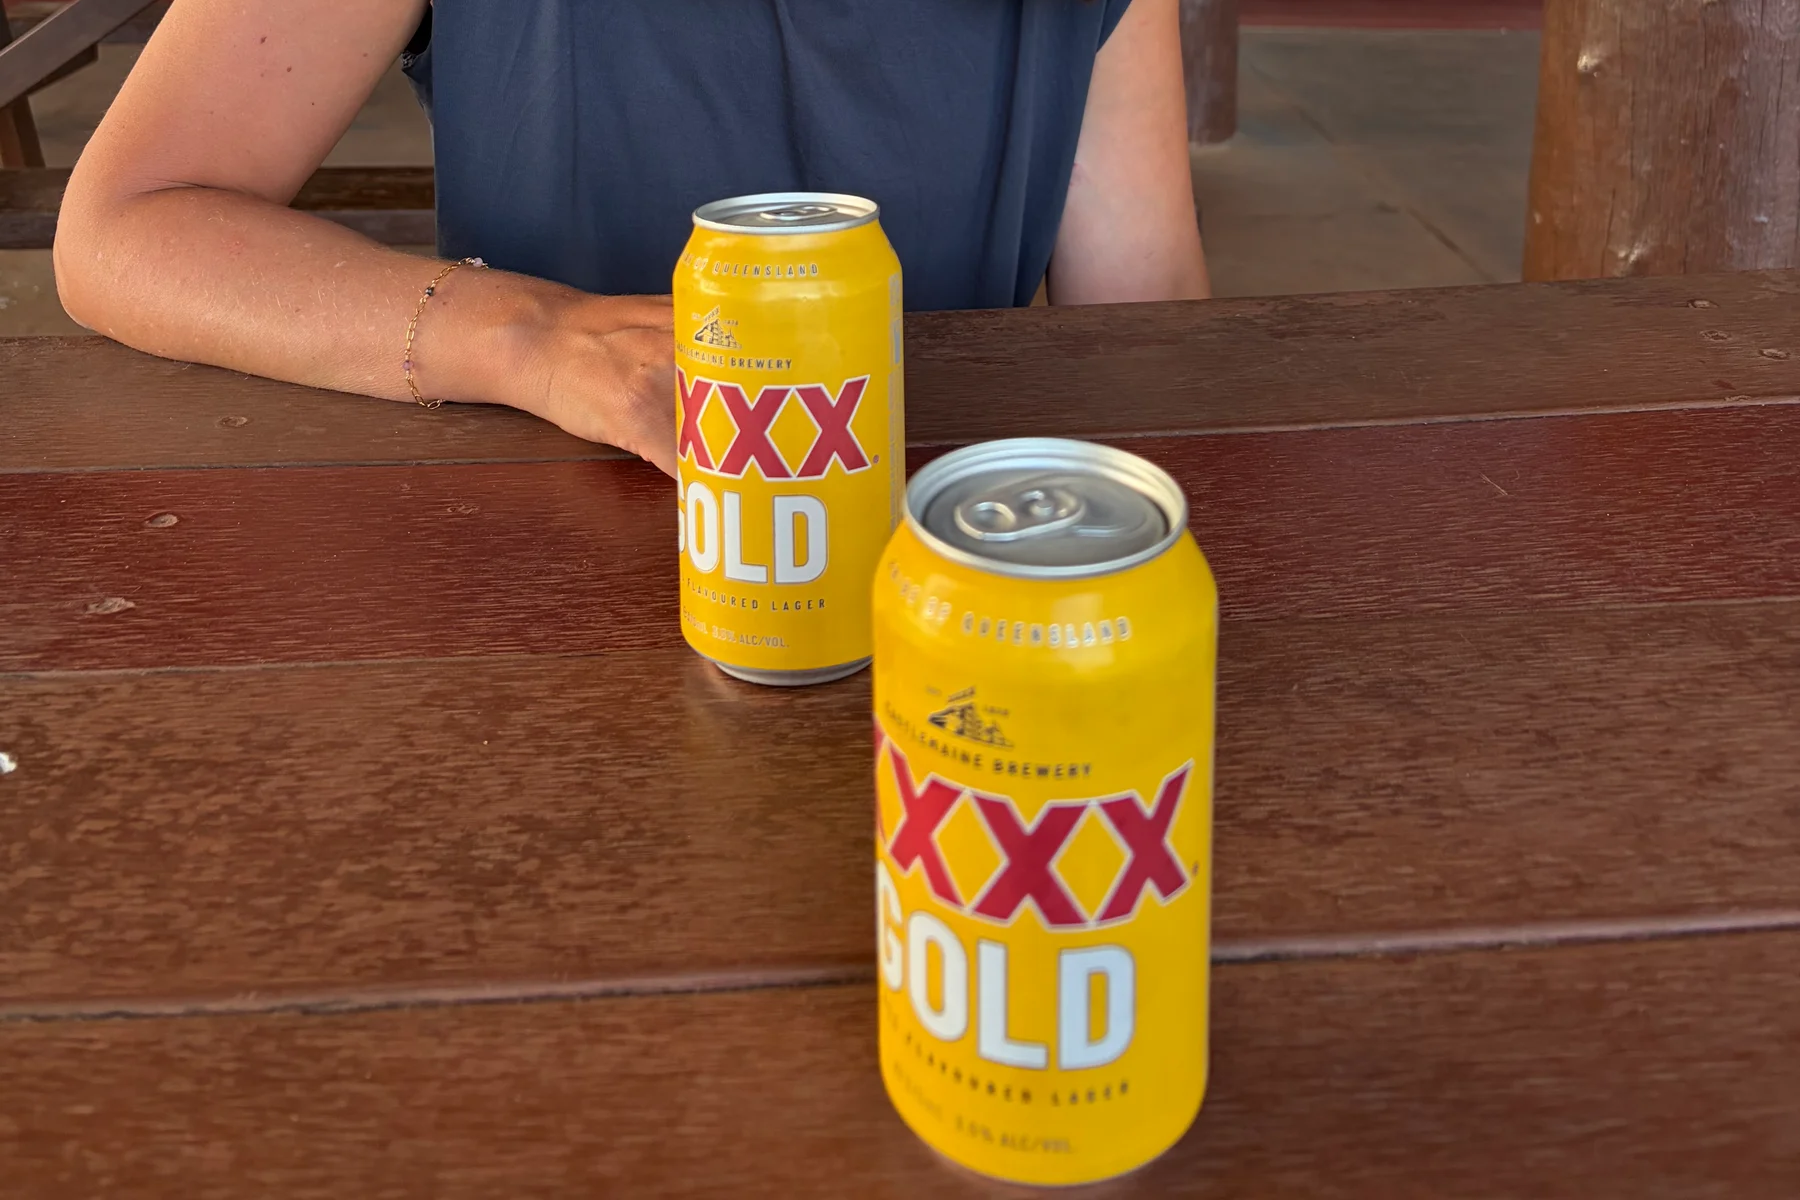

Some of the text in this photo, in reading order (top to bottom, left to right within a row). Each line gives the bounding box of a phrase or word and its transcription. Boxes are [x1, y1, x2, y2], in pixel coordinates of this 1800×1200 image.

[713, 261, 819, 277] QUEENSLAND
[730, 357, 792, 369] BREWERY
[687, 578, 826, 611] FLAVOURED LAGER
[961, 611, 1131, 649] QUEENSLAND
[993, 758, 1092, 780] BREWERY
[874, 714, 1195, 933] XXX
[877, 860, 1137, 1072] GOLD
[905, 1031, 1034, 1105] FLAVOURED
[1051, 1079, 1129, 1107] LAGER
